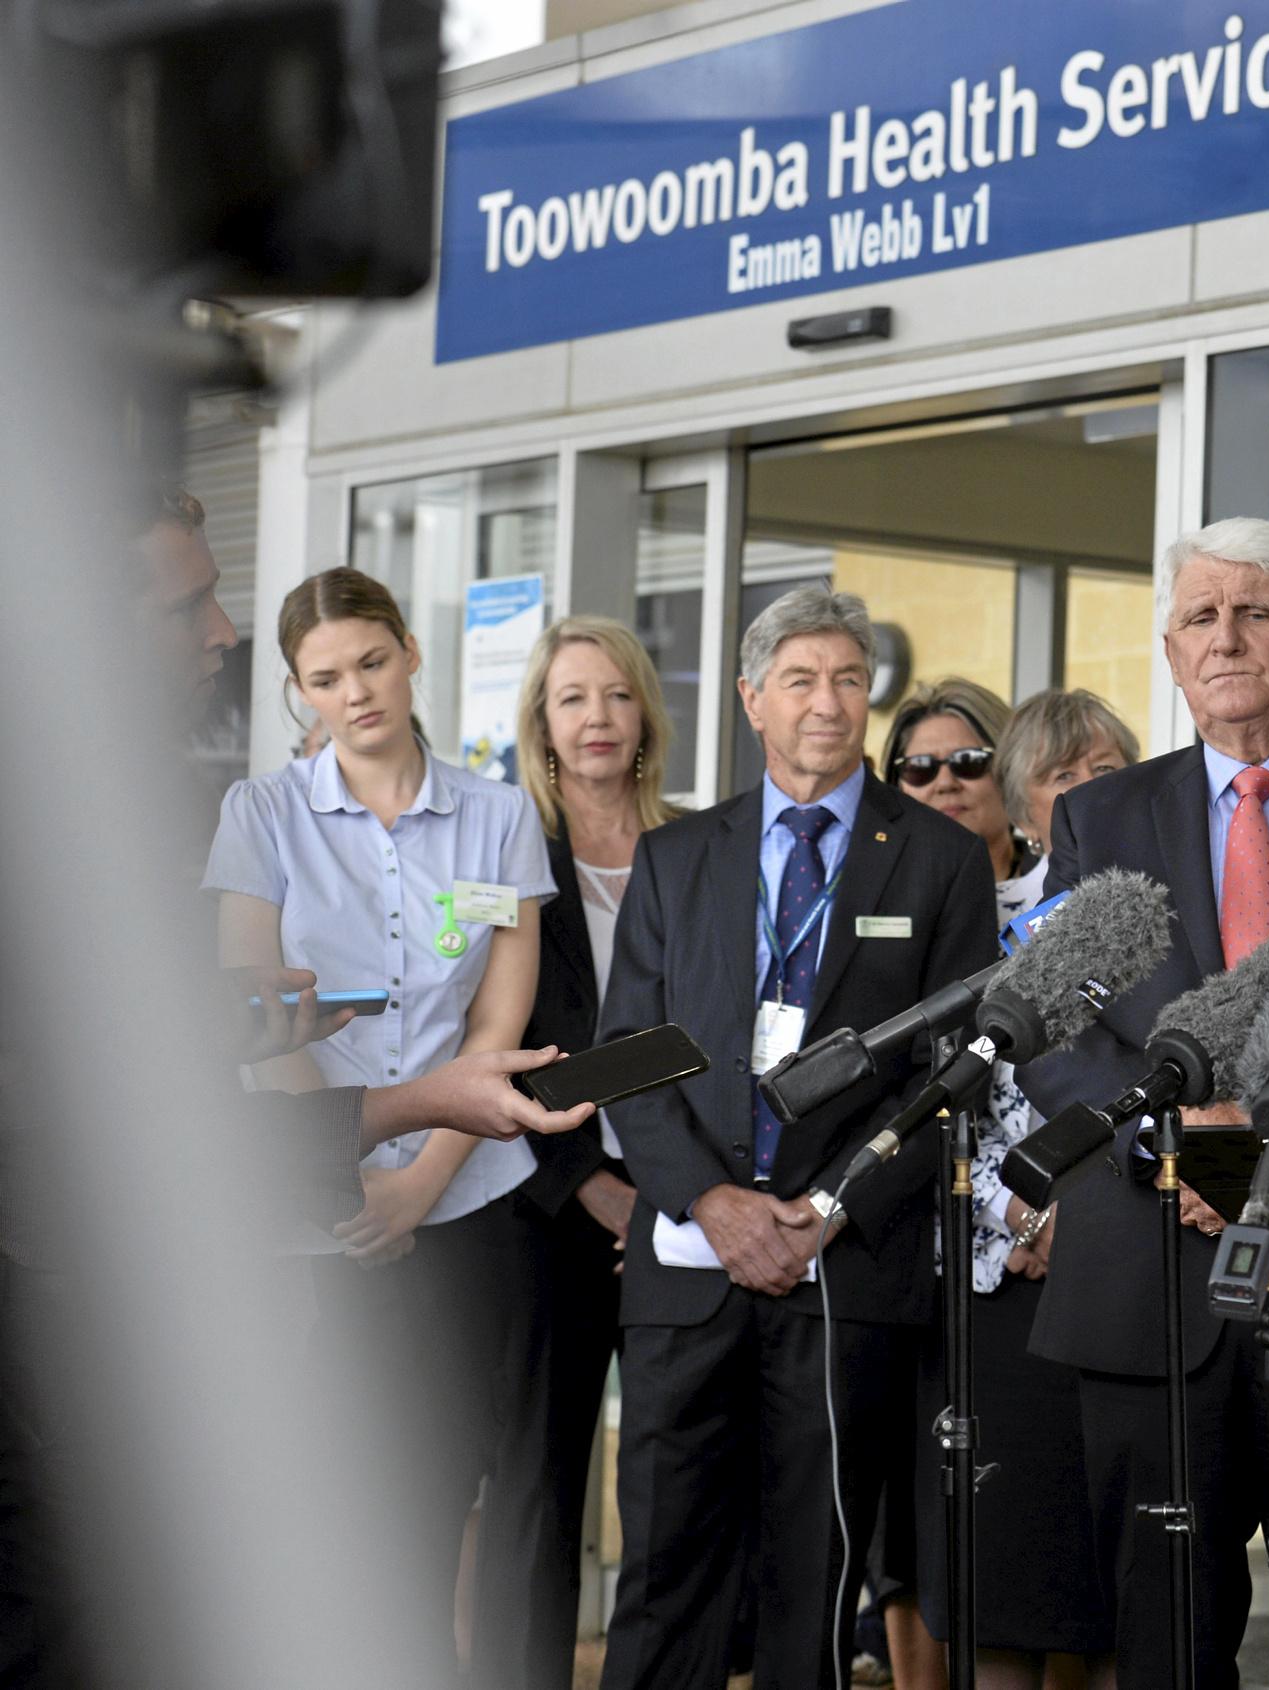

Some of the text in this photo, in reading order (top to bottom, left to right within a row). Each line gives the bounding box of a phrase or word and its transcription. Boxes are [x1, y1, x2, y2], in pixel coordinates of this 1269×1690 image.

[479, 128, 808, 272] Toowoomba
[828, 61, 1037, 199] Health
[729, 184, 990, 293] Emma Webb Lv1
